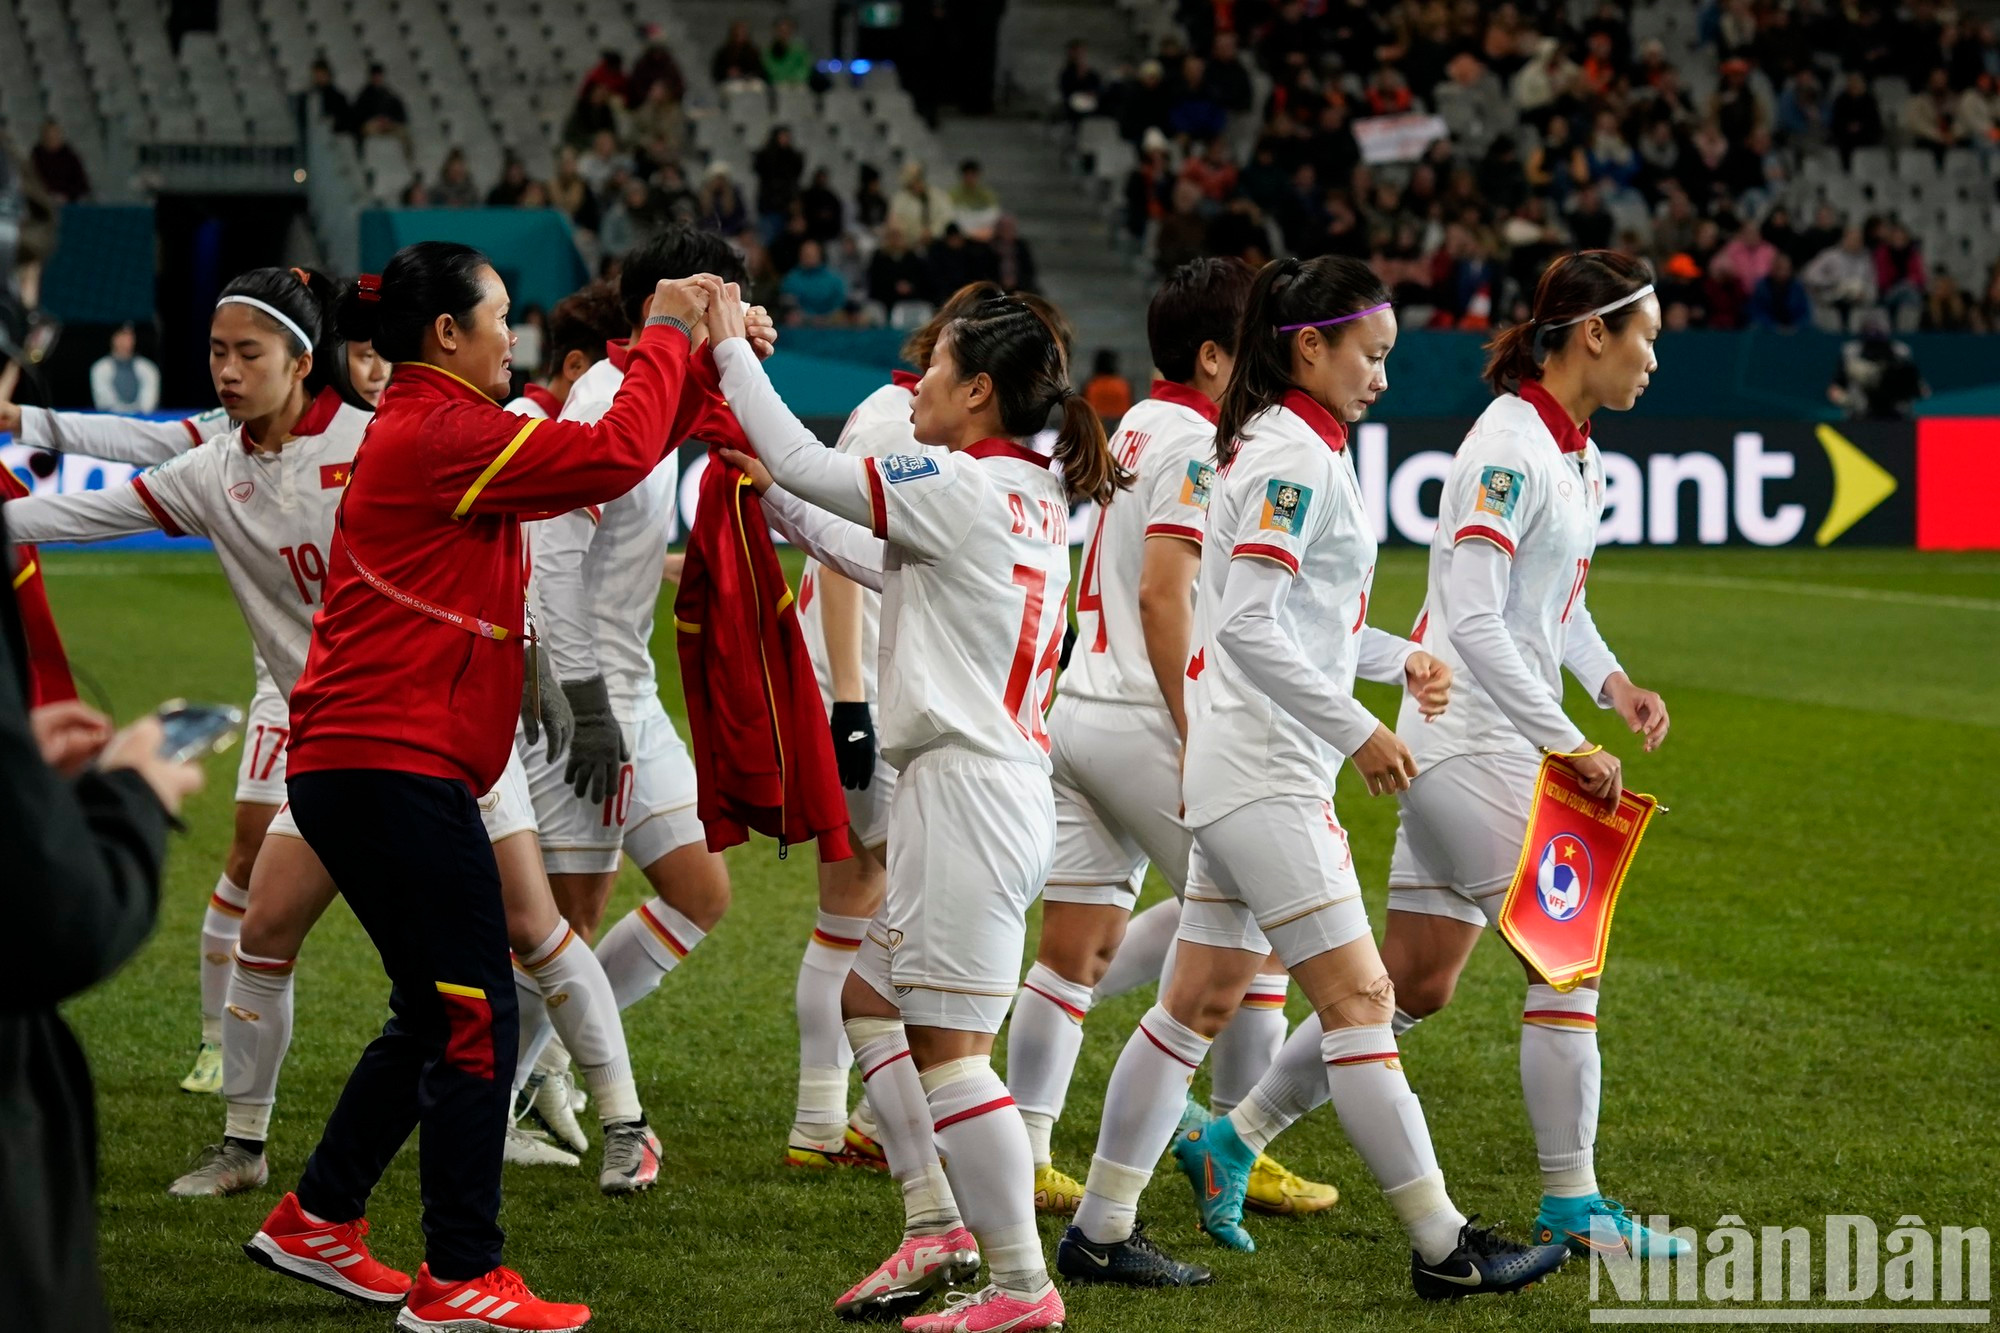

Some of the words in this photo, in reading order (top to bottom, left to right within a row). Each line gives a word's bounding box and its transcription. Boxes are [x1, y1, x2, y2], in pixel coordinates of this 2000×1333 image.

[278, 542, 328, 606] 19
[373, 579, 389, 592] CUP
[387, 588, 414, 606] WORLD
[413, 599, 448, 621] WOMEN'S
[1002, 562, 1070, 756] 16
[249, 724, 289, 782] 17
[1566, 791, 1599, 820] FOOTBALL
[1549, 894, 1567, 910] VFF
